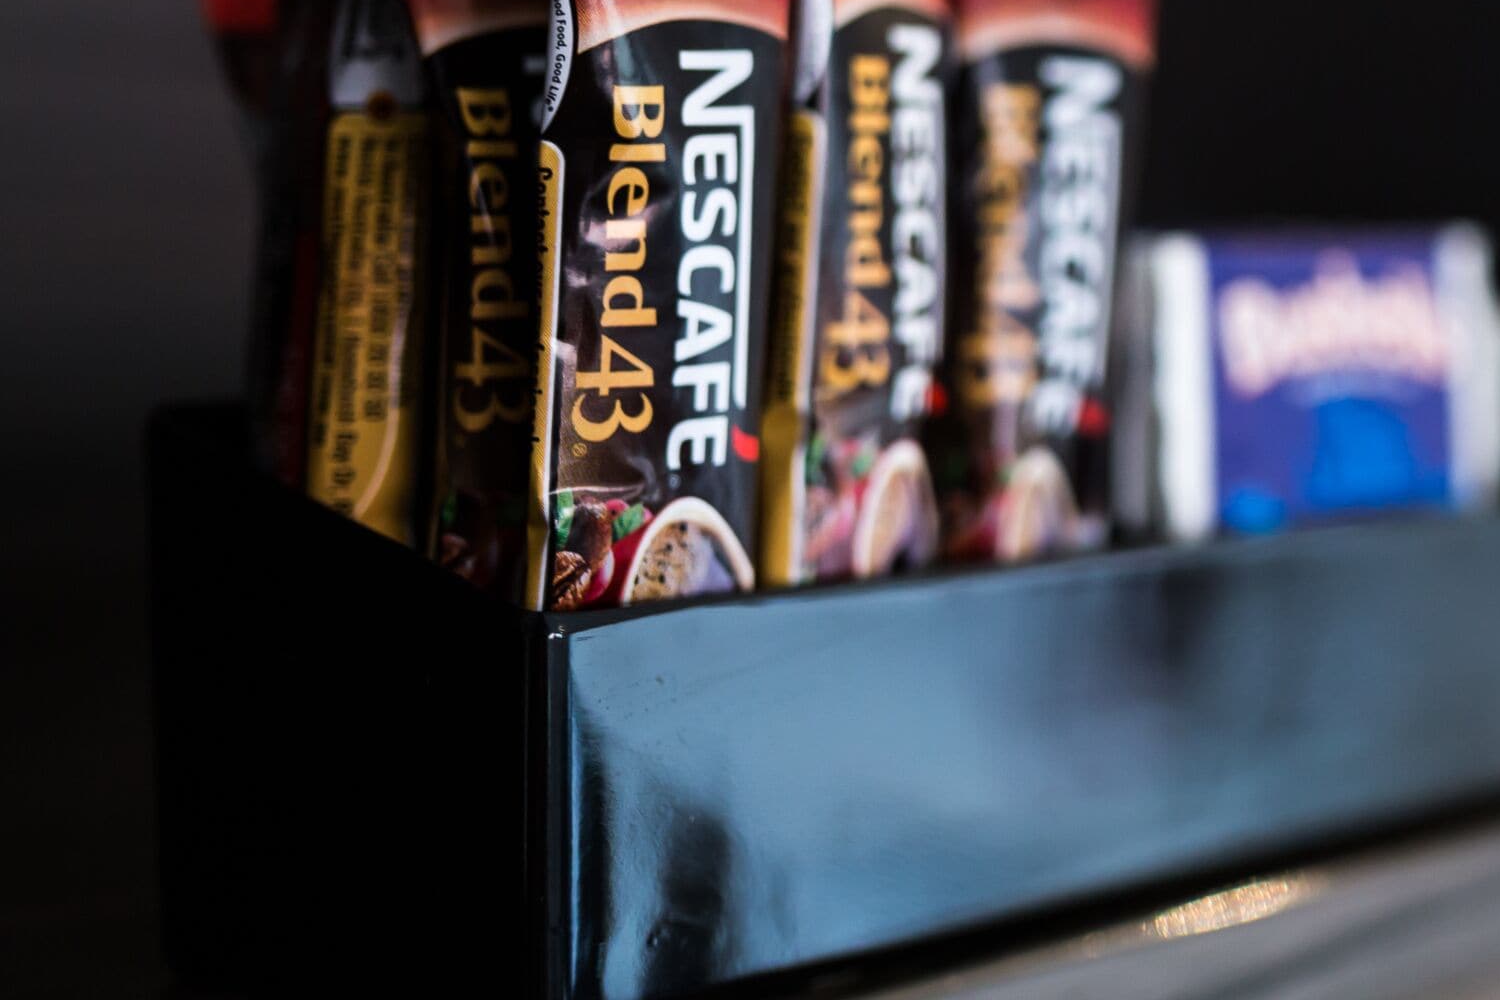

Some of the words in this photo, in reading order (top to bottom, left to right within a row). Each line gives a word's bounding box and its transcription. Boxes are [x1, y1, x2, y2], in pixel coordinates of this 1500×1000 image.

[555, 19, 568, 51] Food,
[552, 54, 566, 84] Good
[666, 49, 760, 470] NESCAFÉ
